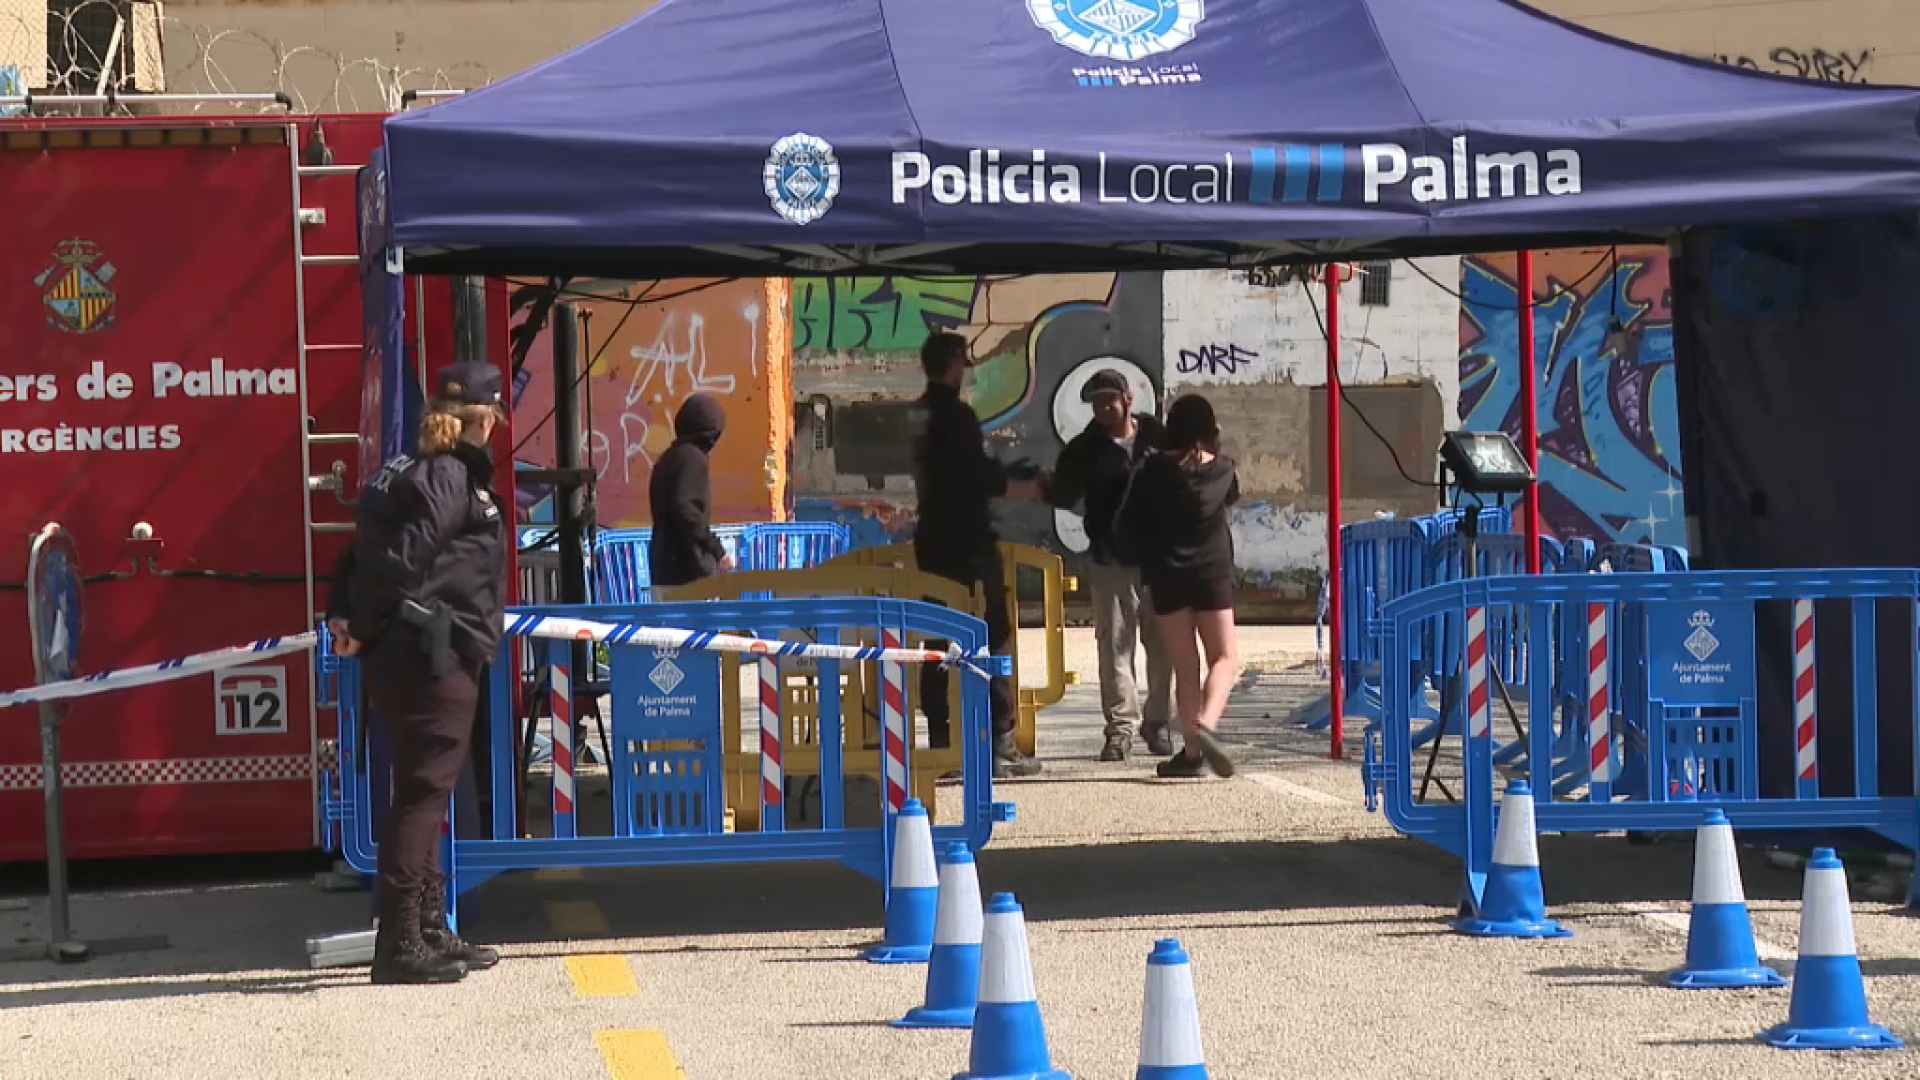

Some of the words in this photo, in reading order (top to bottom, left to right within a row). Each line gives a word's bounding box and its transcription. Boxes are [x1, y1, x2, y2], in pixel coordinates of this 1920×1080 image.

[1118, 73, 1202, 86] Palma
[892, 149, 1082, 204] Policia
[1098, 151, 1234, 203] Local
[1362, 135, 1582, 203] Palma
[76, 361, 134, 400] de
[152, 358, 297, 398] Palma
[1671, 662, 1732, 674] Ajuntament
[1679, 673, 1692, 684] de
[1694, 673, 1724, 684] Palma
[637, 695, 697, 707] Ajuntament
[221, 691, 282, 730] 112
[644, 706, 658, 717] de
[660, 706, 691, 717] Palma
